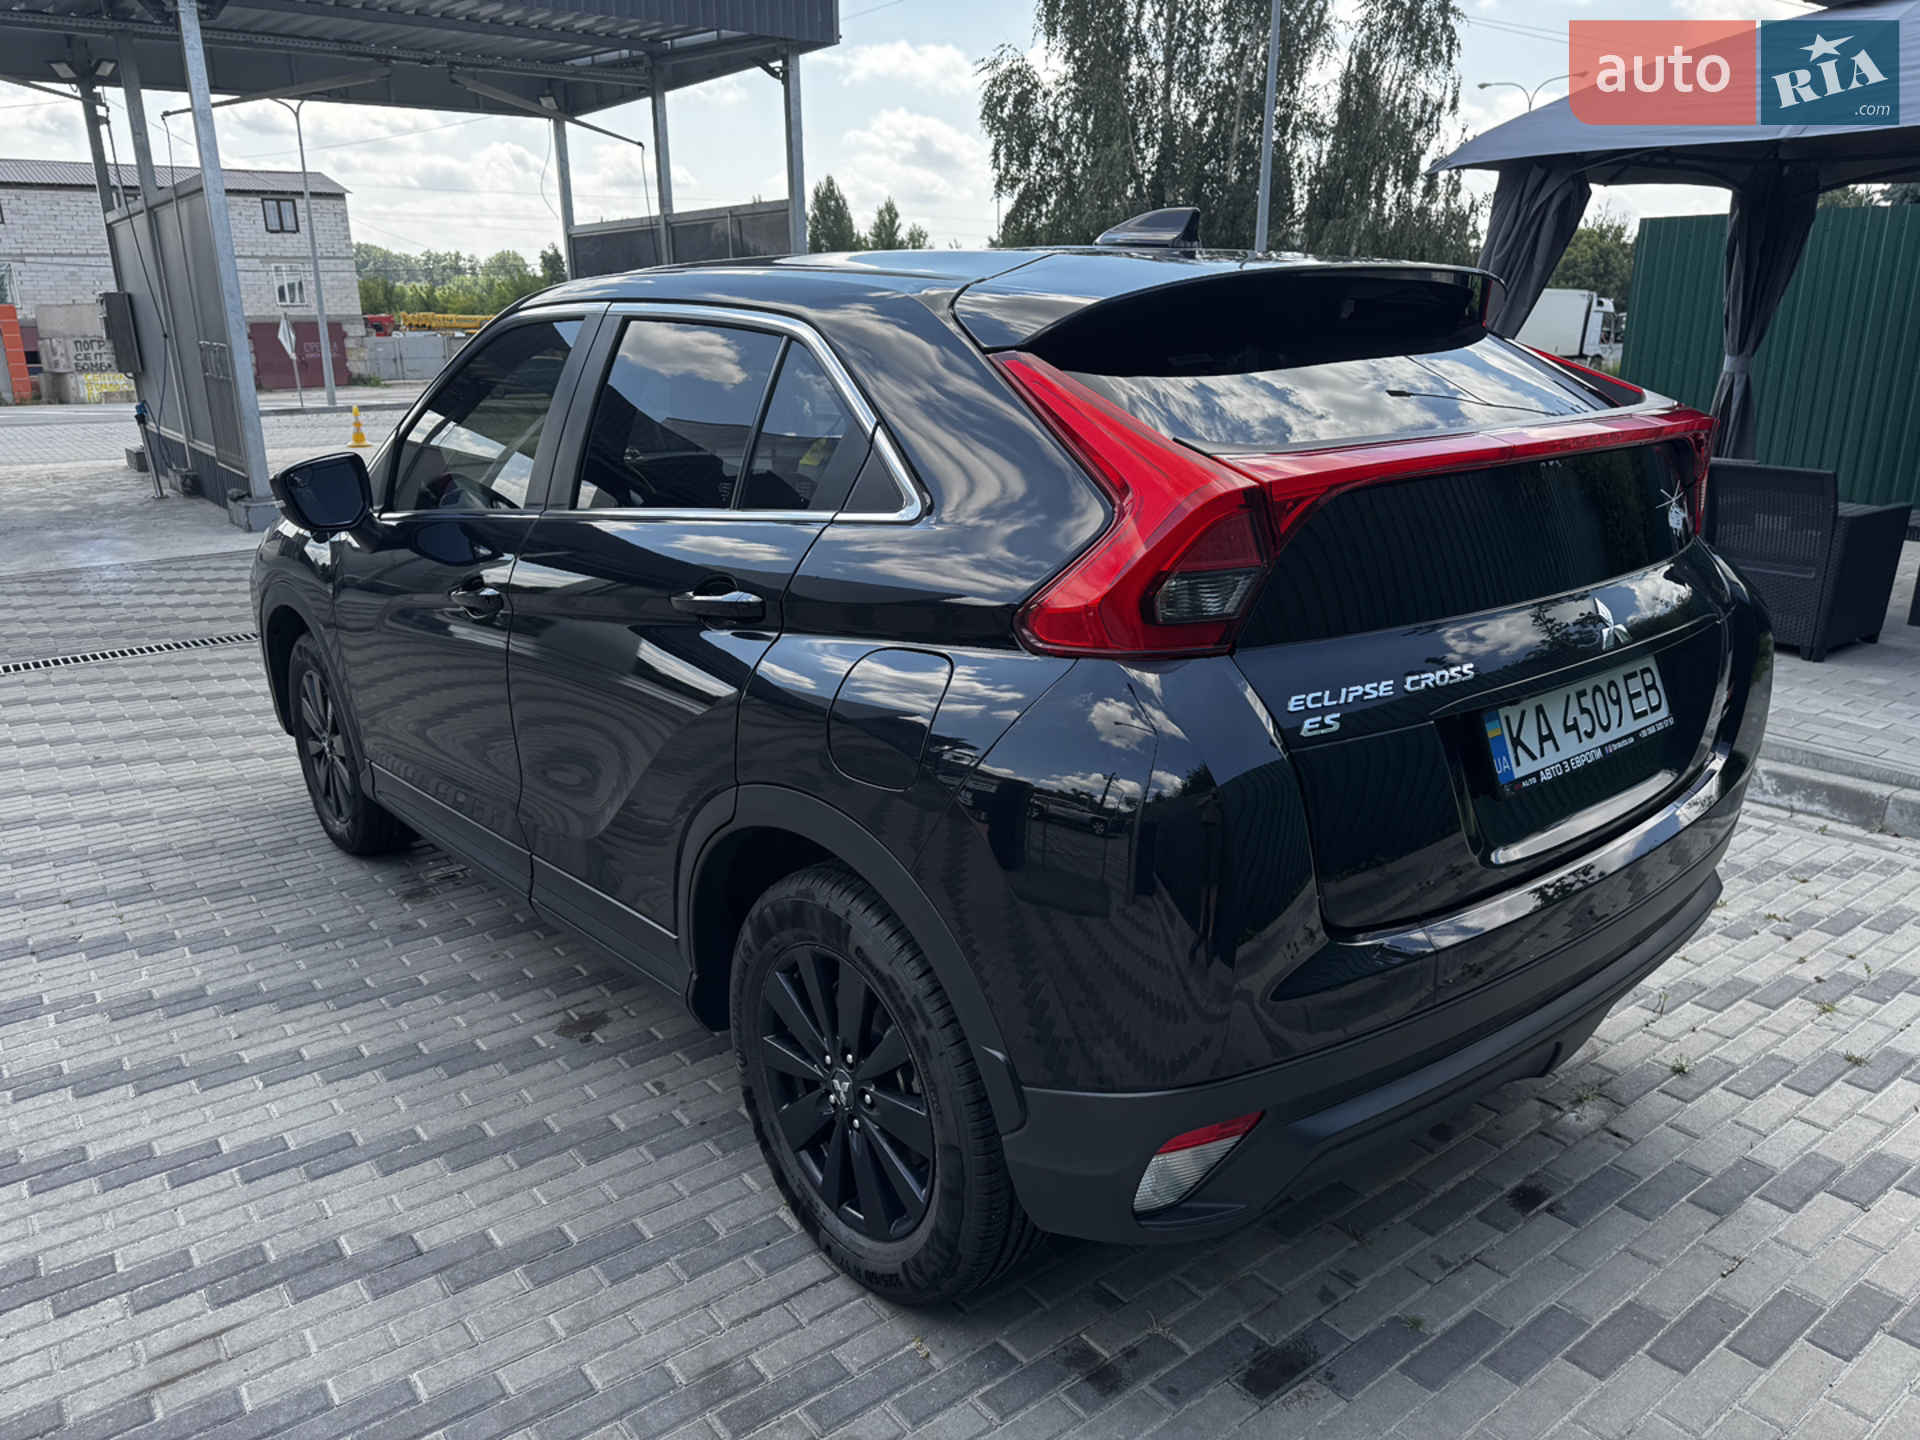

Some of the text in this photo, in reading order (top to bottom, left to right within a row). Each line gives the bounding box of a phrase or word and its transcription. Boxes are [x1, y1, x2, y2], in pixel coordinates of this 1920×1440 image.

[74, 339, 106, 352] ПОГР
[1287, 662, 1475, 712] ECLIPSE CROSS
[1300, 712, 1341, 737] ES
[1505, 666, 1662, 768] KA 4509 EB
[1493, 756, 1511, 774] UA
[1540, 763, 1563, 783] АВТО
